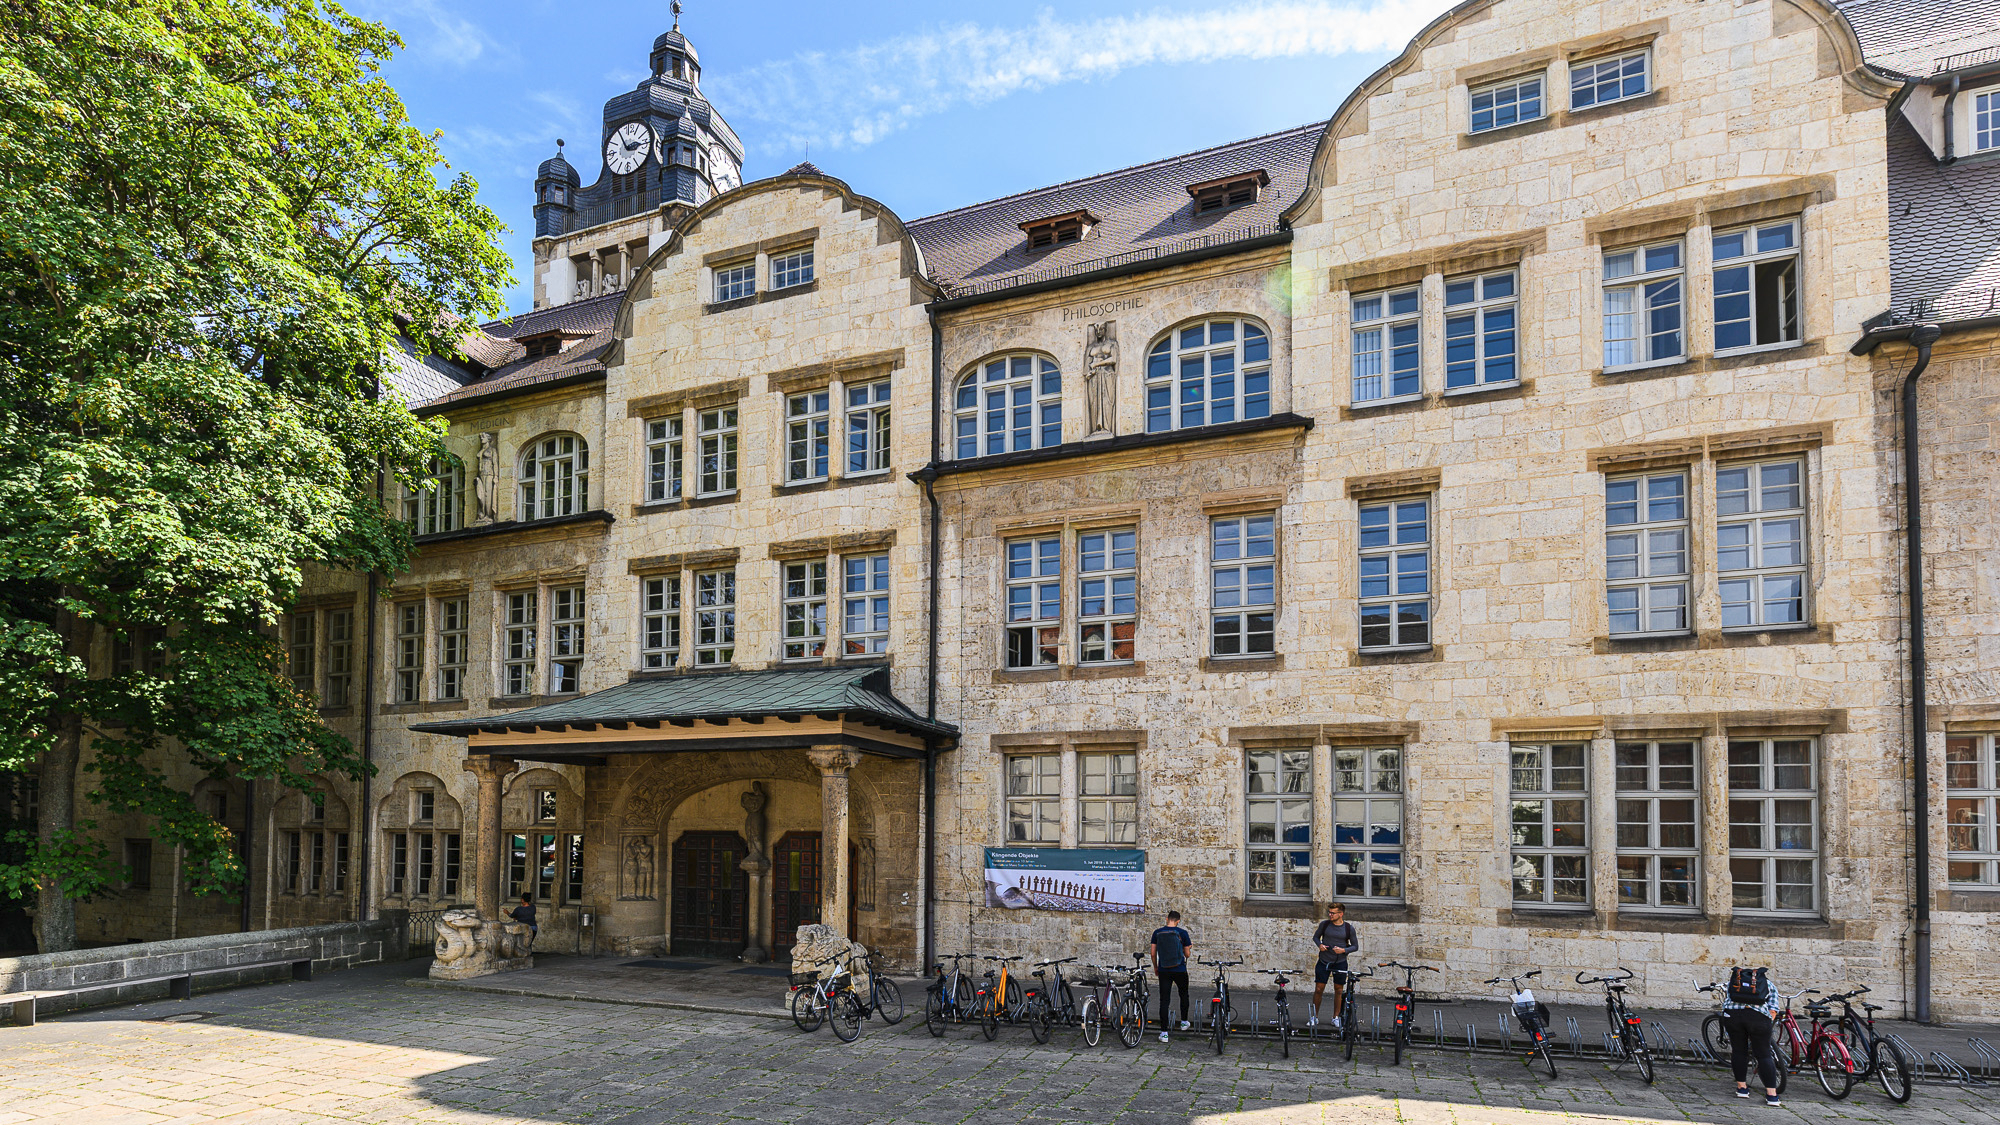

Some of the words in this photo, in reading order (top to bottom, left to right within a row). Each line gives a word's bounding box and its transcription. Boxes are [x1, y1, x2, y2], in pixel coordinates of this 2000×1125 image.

[623, 124, 634, 135] 12
[1063, 297, 1143, 321] PHILOSOPHIE
[470, 417, 510, 432] MEDICIN
